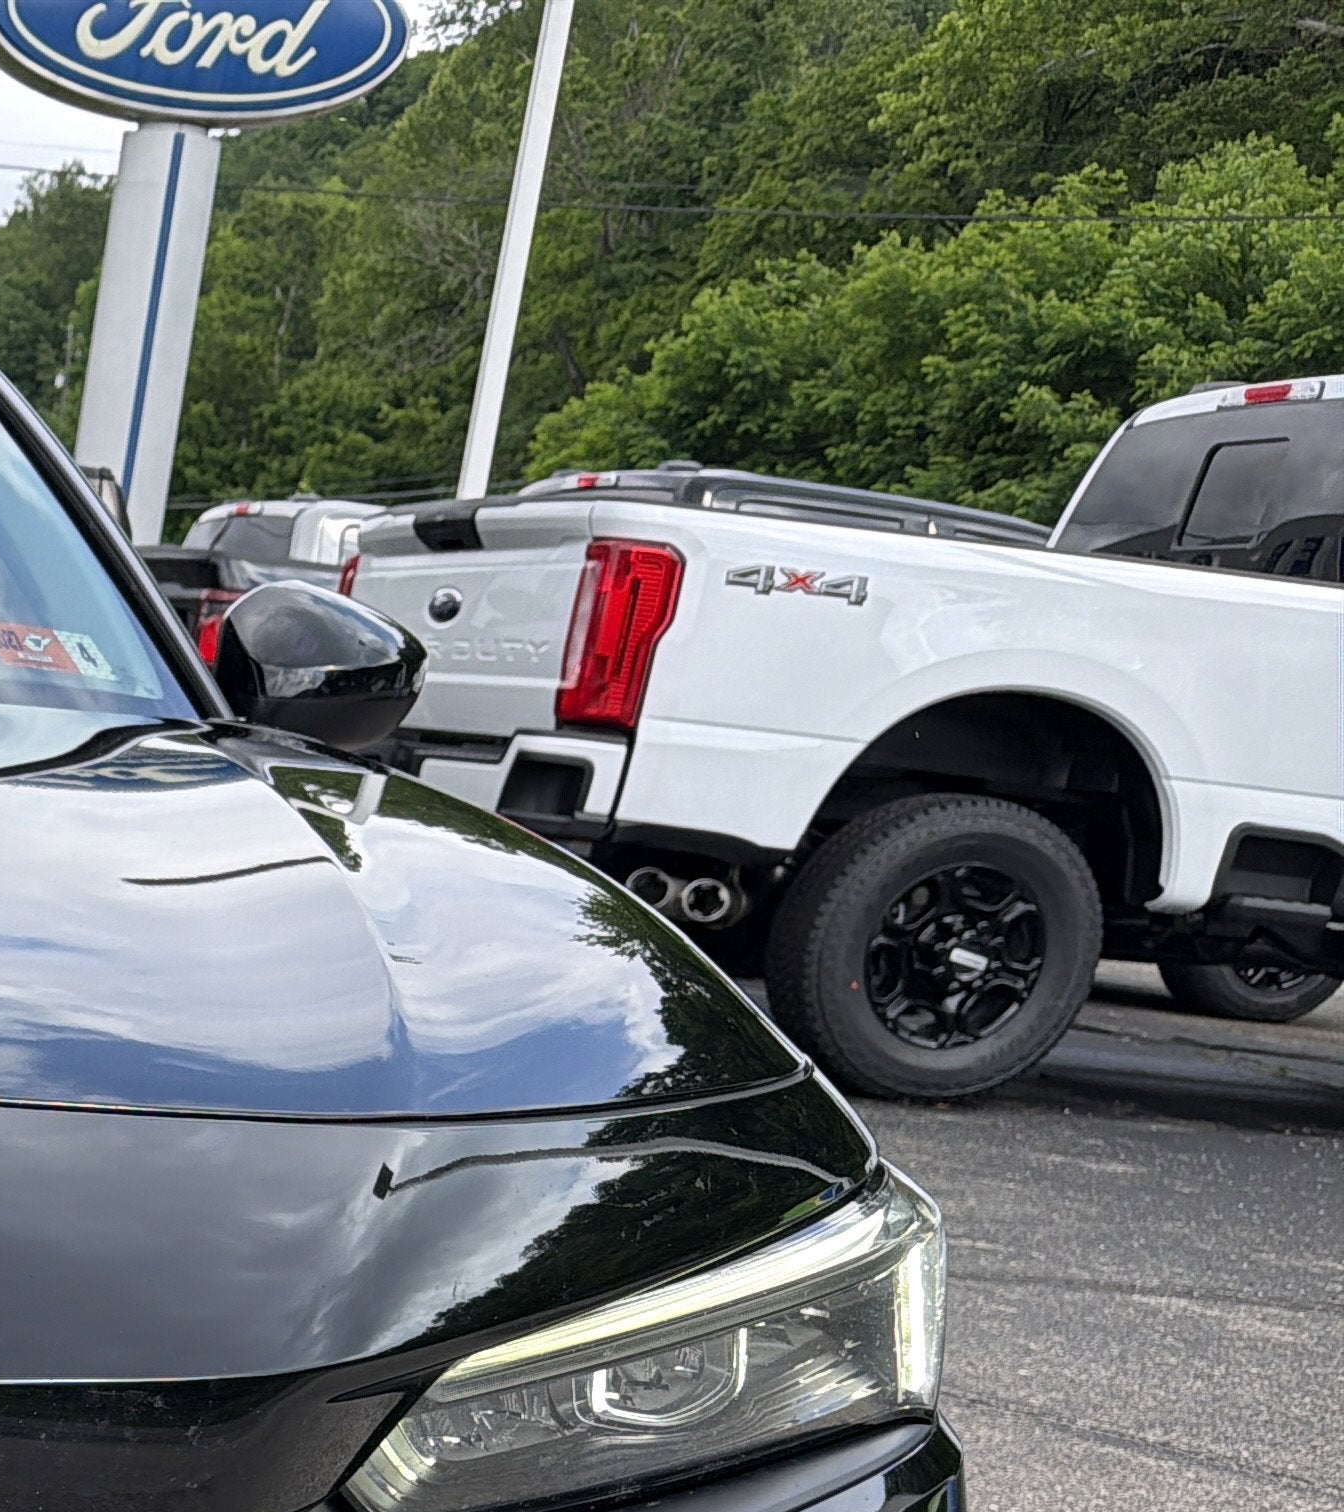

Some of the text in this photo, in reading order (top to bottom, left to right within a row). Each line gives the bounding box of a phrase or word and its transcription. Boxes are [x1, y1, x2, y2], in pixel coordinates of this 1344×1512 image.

[76, 0, 331, 77] Ford
[76, 641, 98, 668] 4
[451, 638, 549, 662] DUTY
